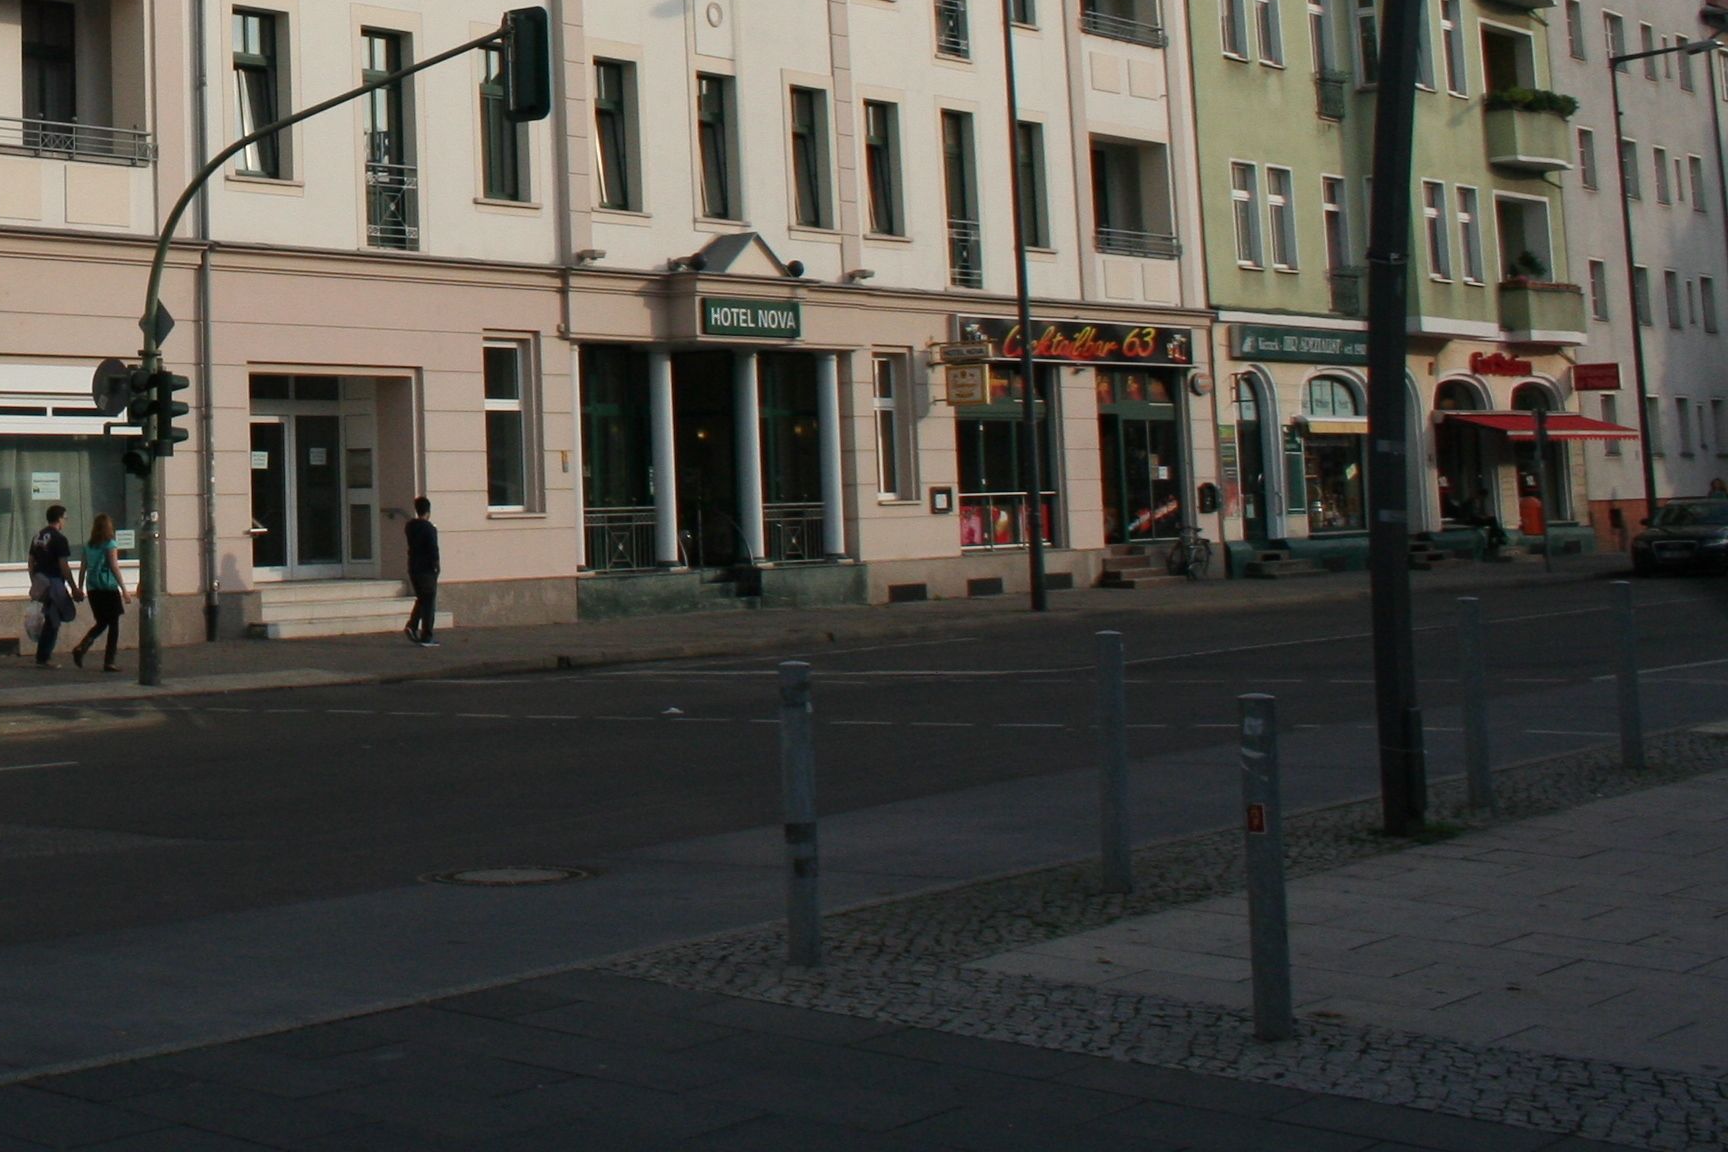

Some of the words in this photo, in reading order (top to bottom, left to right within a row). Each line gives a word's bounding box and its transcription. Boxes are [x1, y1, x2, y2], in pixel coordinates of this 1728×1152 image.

[711, 307, 756, 327] HOTEL
[758, 310, 796, 329] NOVA
[1002, 324, 1119, 360] Ccktailbar
[1122, 328, 1157, 357] 63
